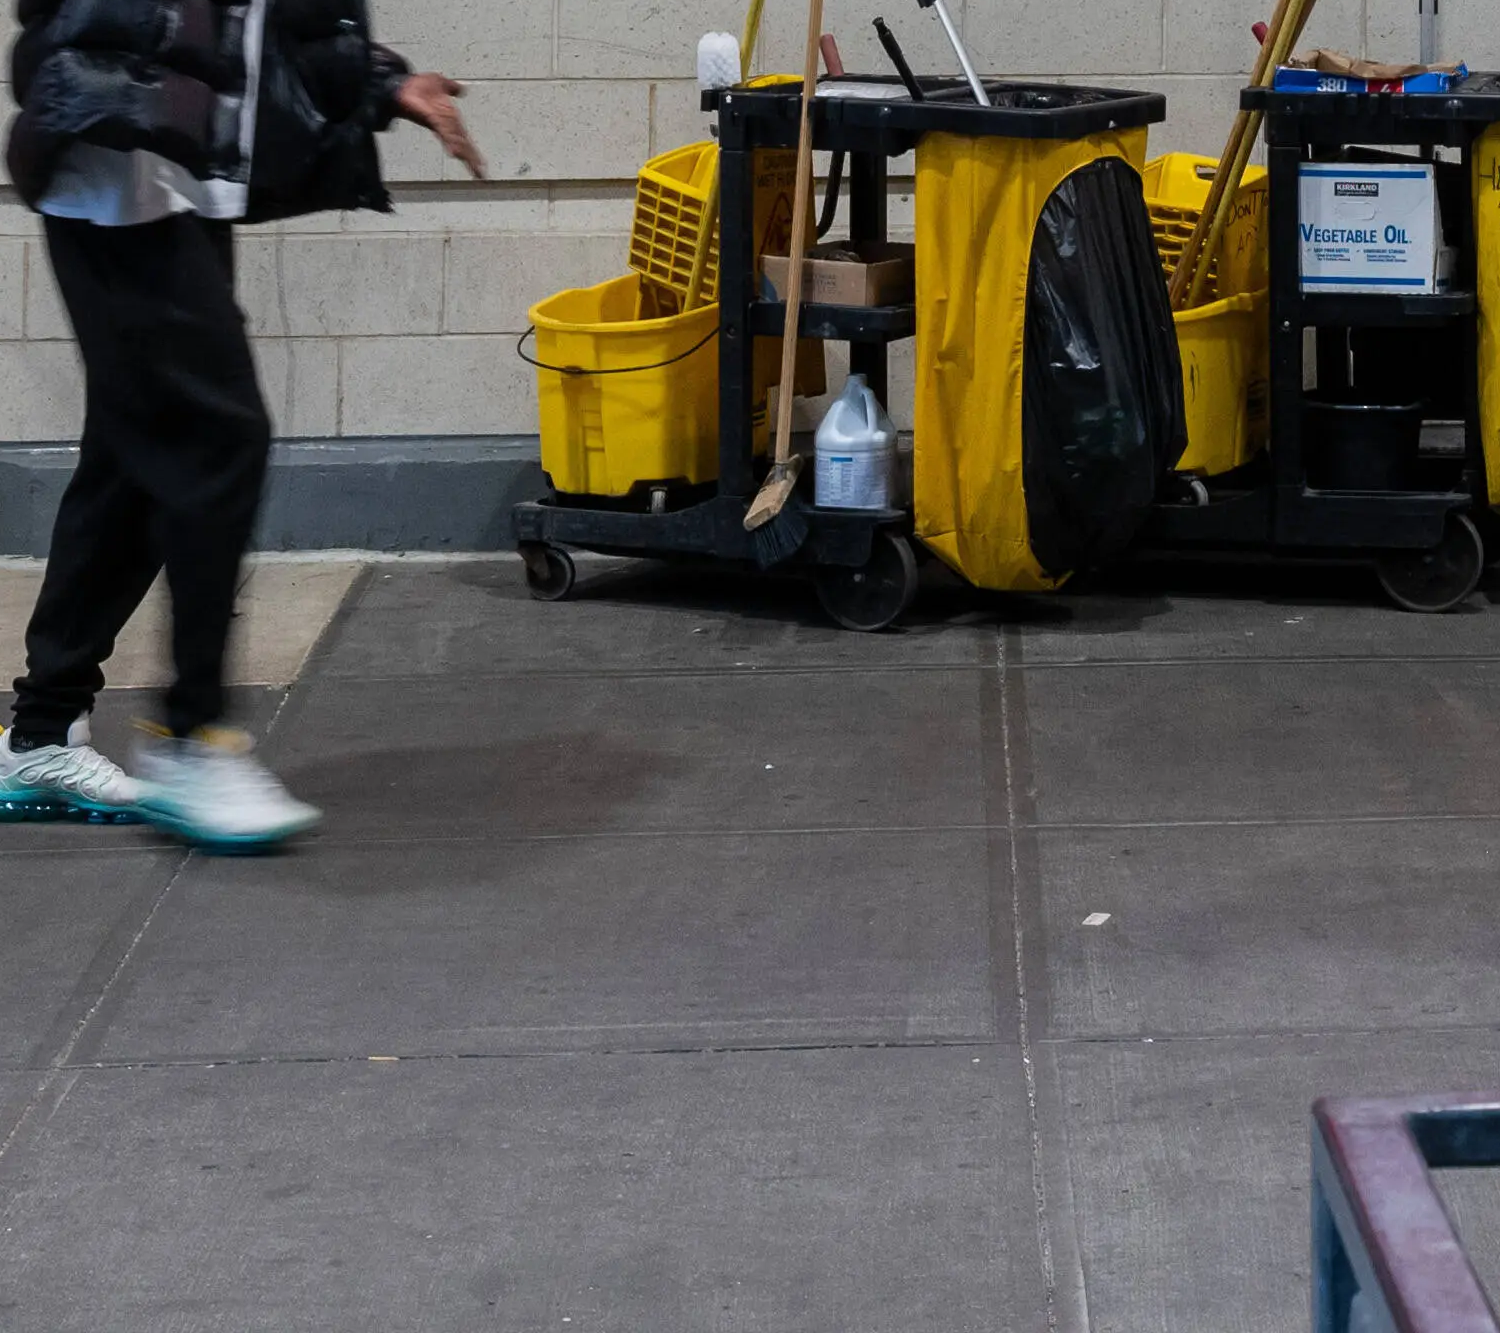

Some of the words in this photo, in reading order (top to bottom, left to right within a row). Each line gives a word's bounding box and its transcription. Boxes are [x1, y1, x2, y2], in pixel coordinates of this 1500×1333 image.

[1316, 78, 1348, 93] 380
[1336, 183, 1378, 191] KIRKLAND
[1299, 223, 1377, 243] VEGETABLE
